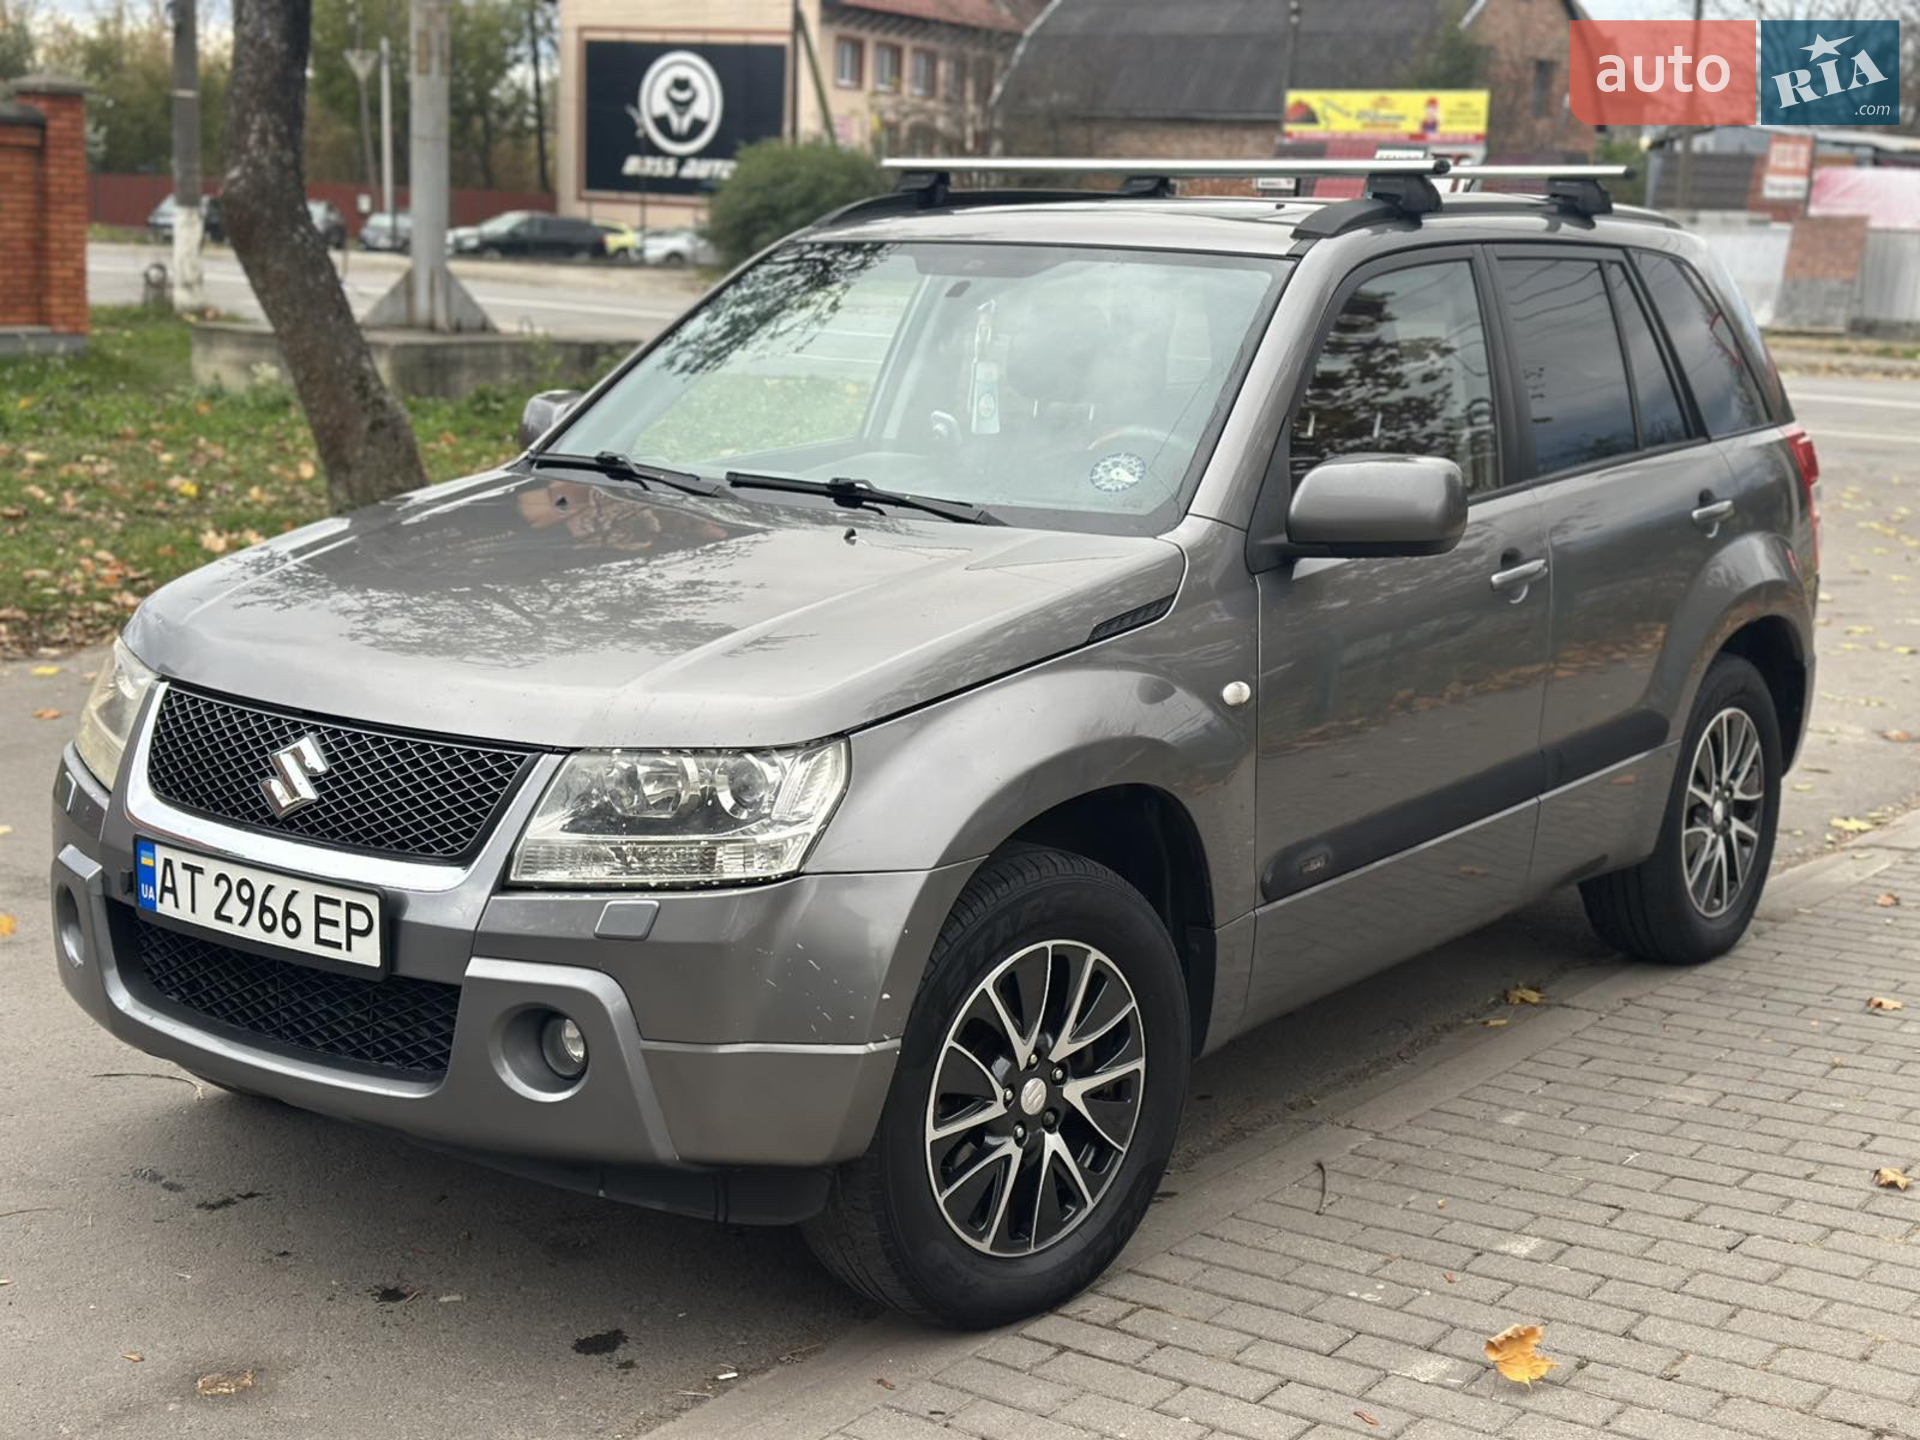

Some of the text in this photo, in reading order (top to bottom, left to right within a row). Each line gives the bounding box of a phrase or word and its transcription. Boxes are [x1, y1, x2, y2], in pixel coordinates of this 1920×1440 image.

[141, 883, 155, 901] UA
[158, 857, 374, 953] AT 2966 EP
